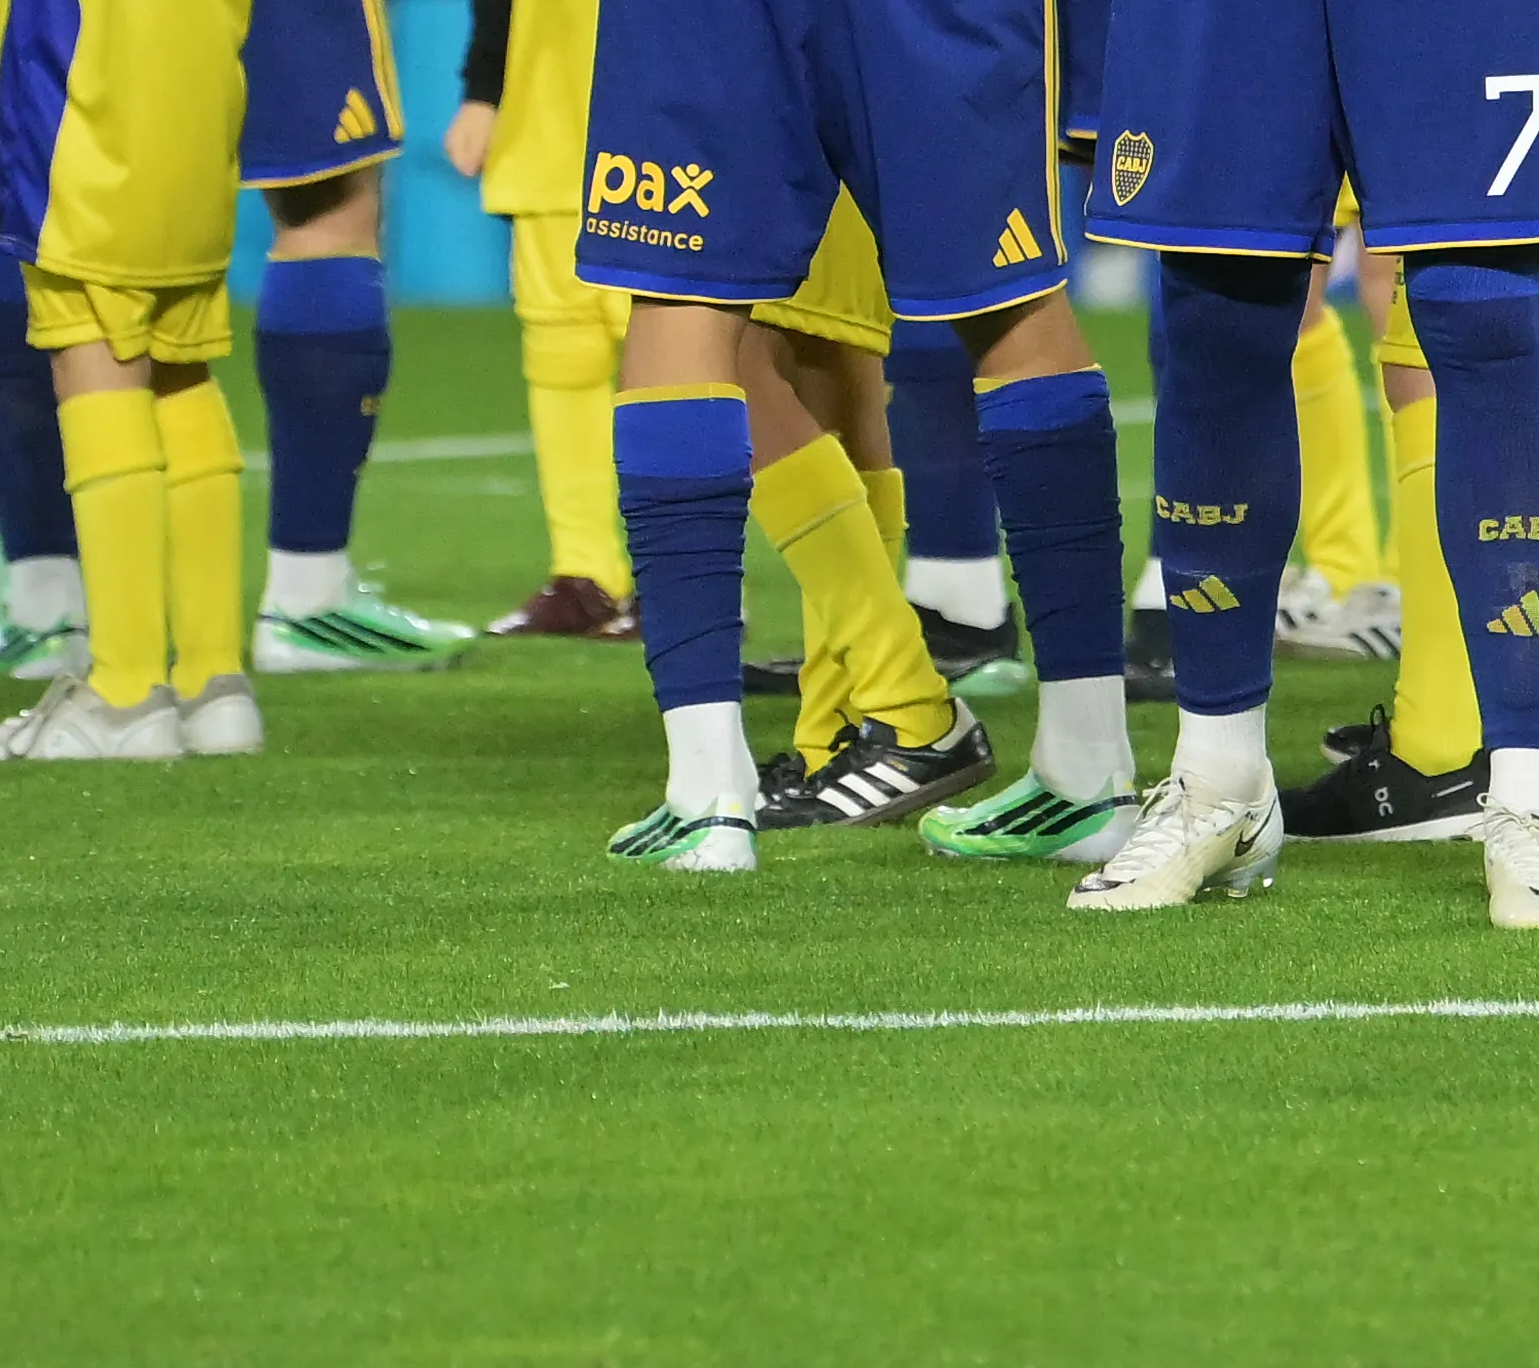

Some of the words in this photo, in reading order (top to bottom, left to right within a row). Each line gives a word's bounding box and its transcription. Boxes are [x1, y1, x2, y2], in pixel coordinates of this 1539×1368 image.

[1116, 155, 1148, 173] CABJ
[587, 151, 715, 218] pax
[585, 216, 705, 253] assistance
[1155, 494, 1248, 526] CABJ
